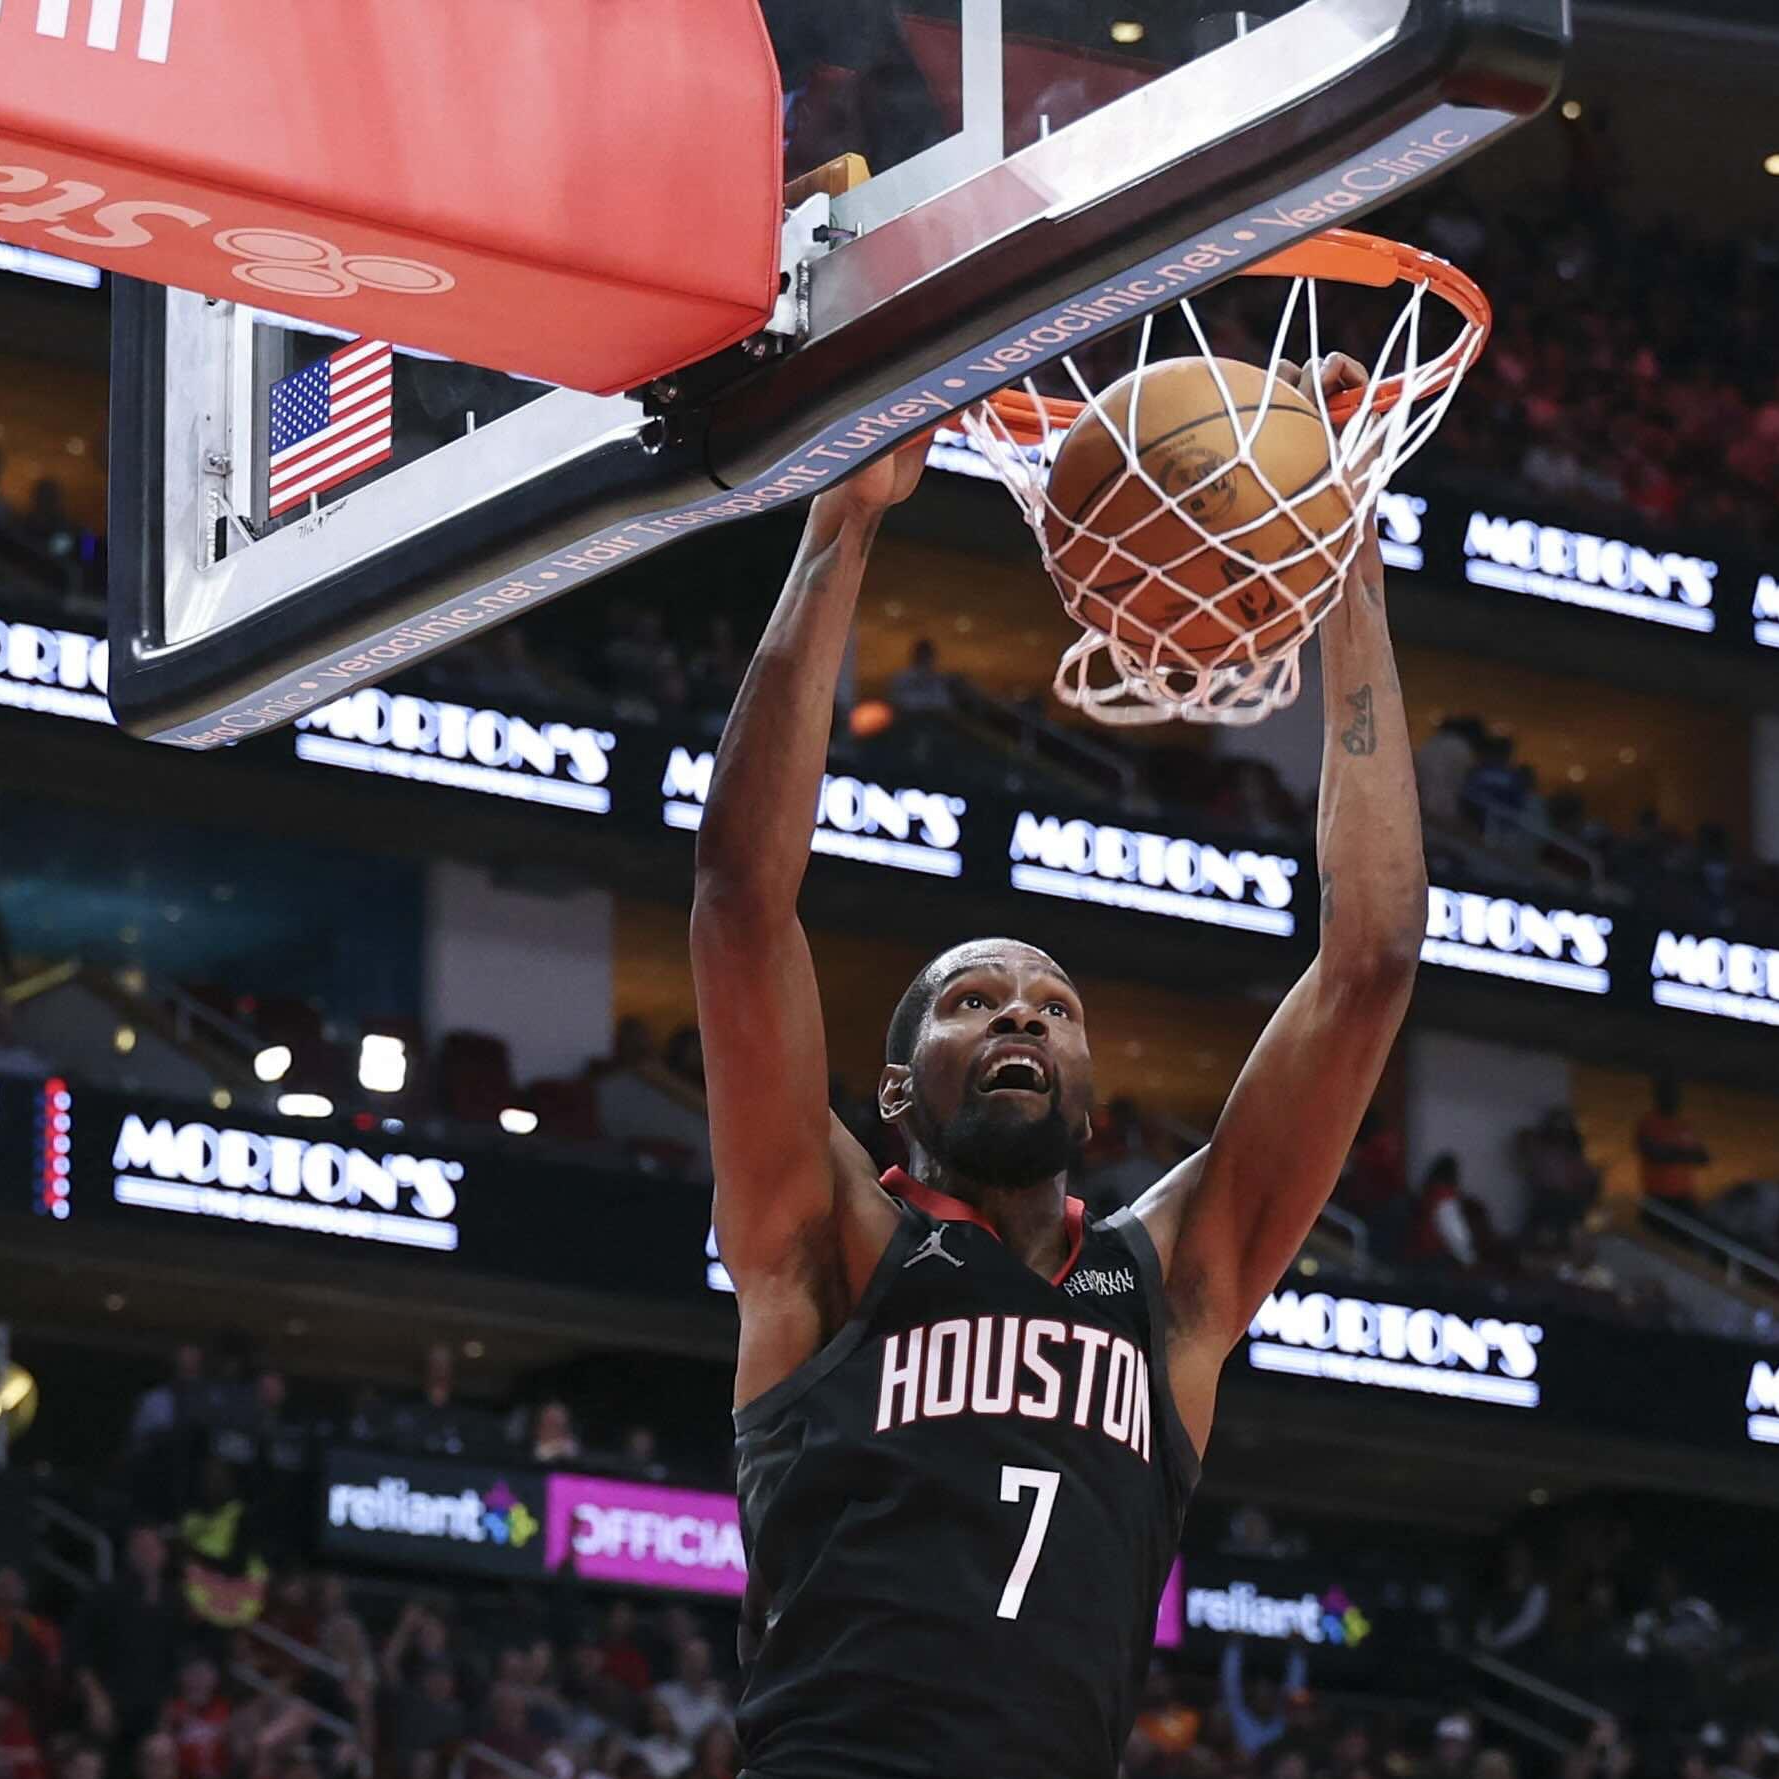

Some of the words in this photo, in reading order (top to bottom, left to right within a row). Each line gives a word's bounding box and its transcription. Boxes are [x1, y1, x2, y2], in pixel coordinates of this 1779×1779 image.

[316, 577, 547, 682] veraclinic.net
[551, 534, 641, 572] Hair
[623, 463, 830, 537] Transplant
[805, 389, 956, 461] Turkey
[967, 240, 1241, 375] veraclinic.net
[1464, 511, 1719, 608] MORTON'S
[1008, 811, 1299, 910] MORTON'S
[112, 1114, 465, 1219] MORTON'S
[1247, 1290, 1544, 1379] MORTON'S
[873, 1314, 1152, 1465] HOUSTON
[328, 1476, 488, 1542] reliant
[996, 1465, 1061, 1620] 7
[1186, 1582, 1324, 1643] reliant
